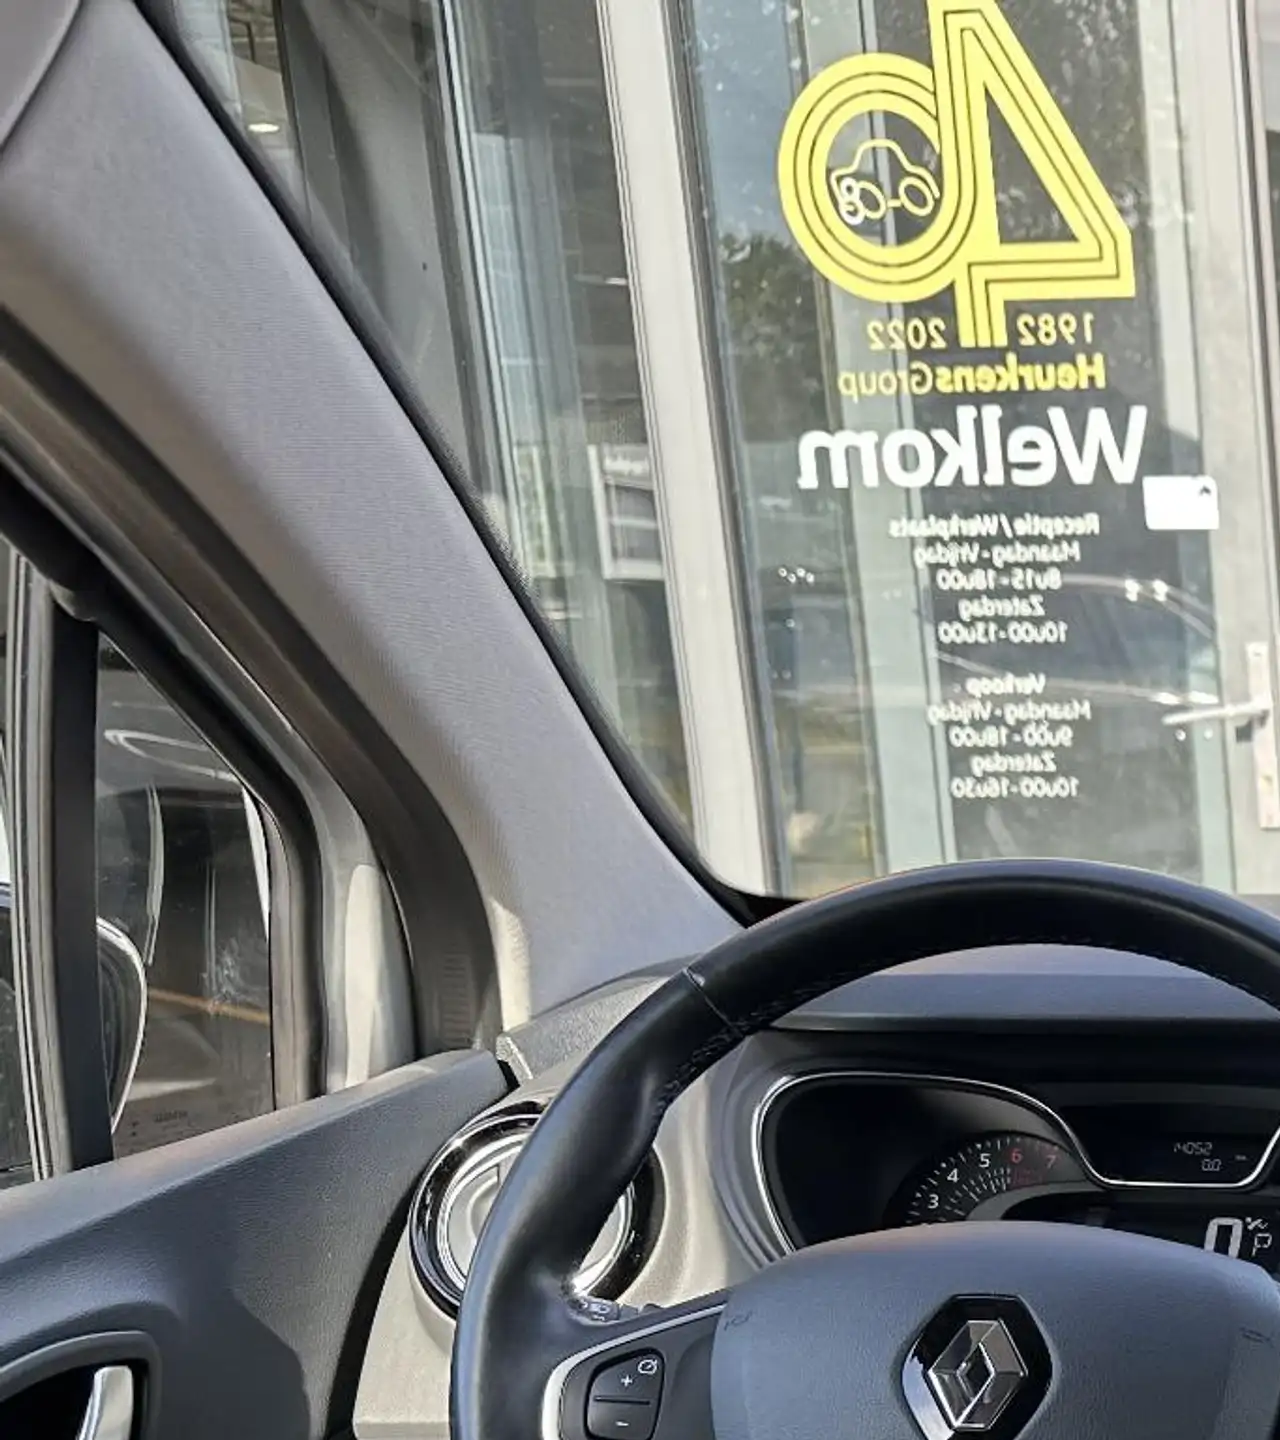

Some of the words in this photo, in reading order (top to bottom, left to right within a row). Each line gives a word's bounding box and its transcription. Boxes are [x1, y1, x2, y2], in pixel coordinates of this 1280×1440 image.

[927, 1193, 940, 1210] 3
[946, 1167, 960, 1183] 4
[978, 1152, 991, 1168] 5
[1010, 1148, 1024, 1164] 6
[1045, 1154, 1058, 1170] 7
[1204, 1216, 1243, 1259] 0
[1251, 1233, 1273, 1257] P
